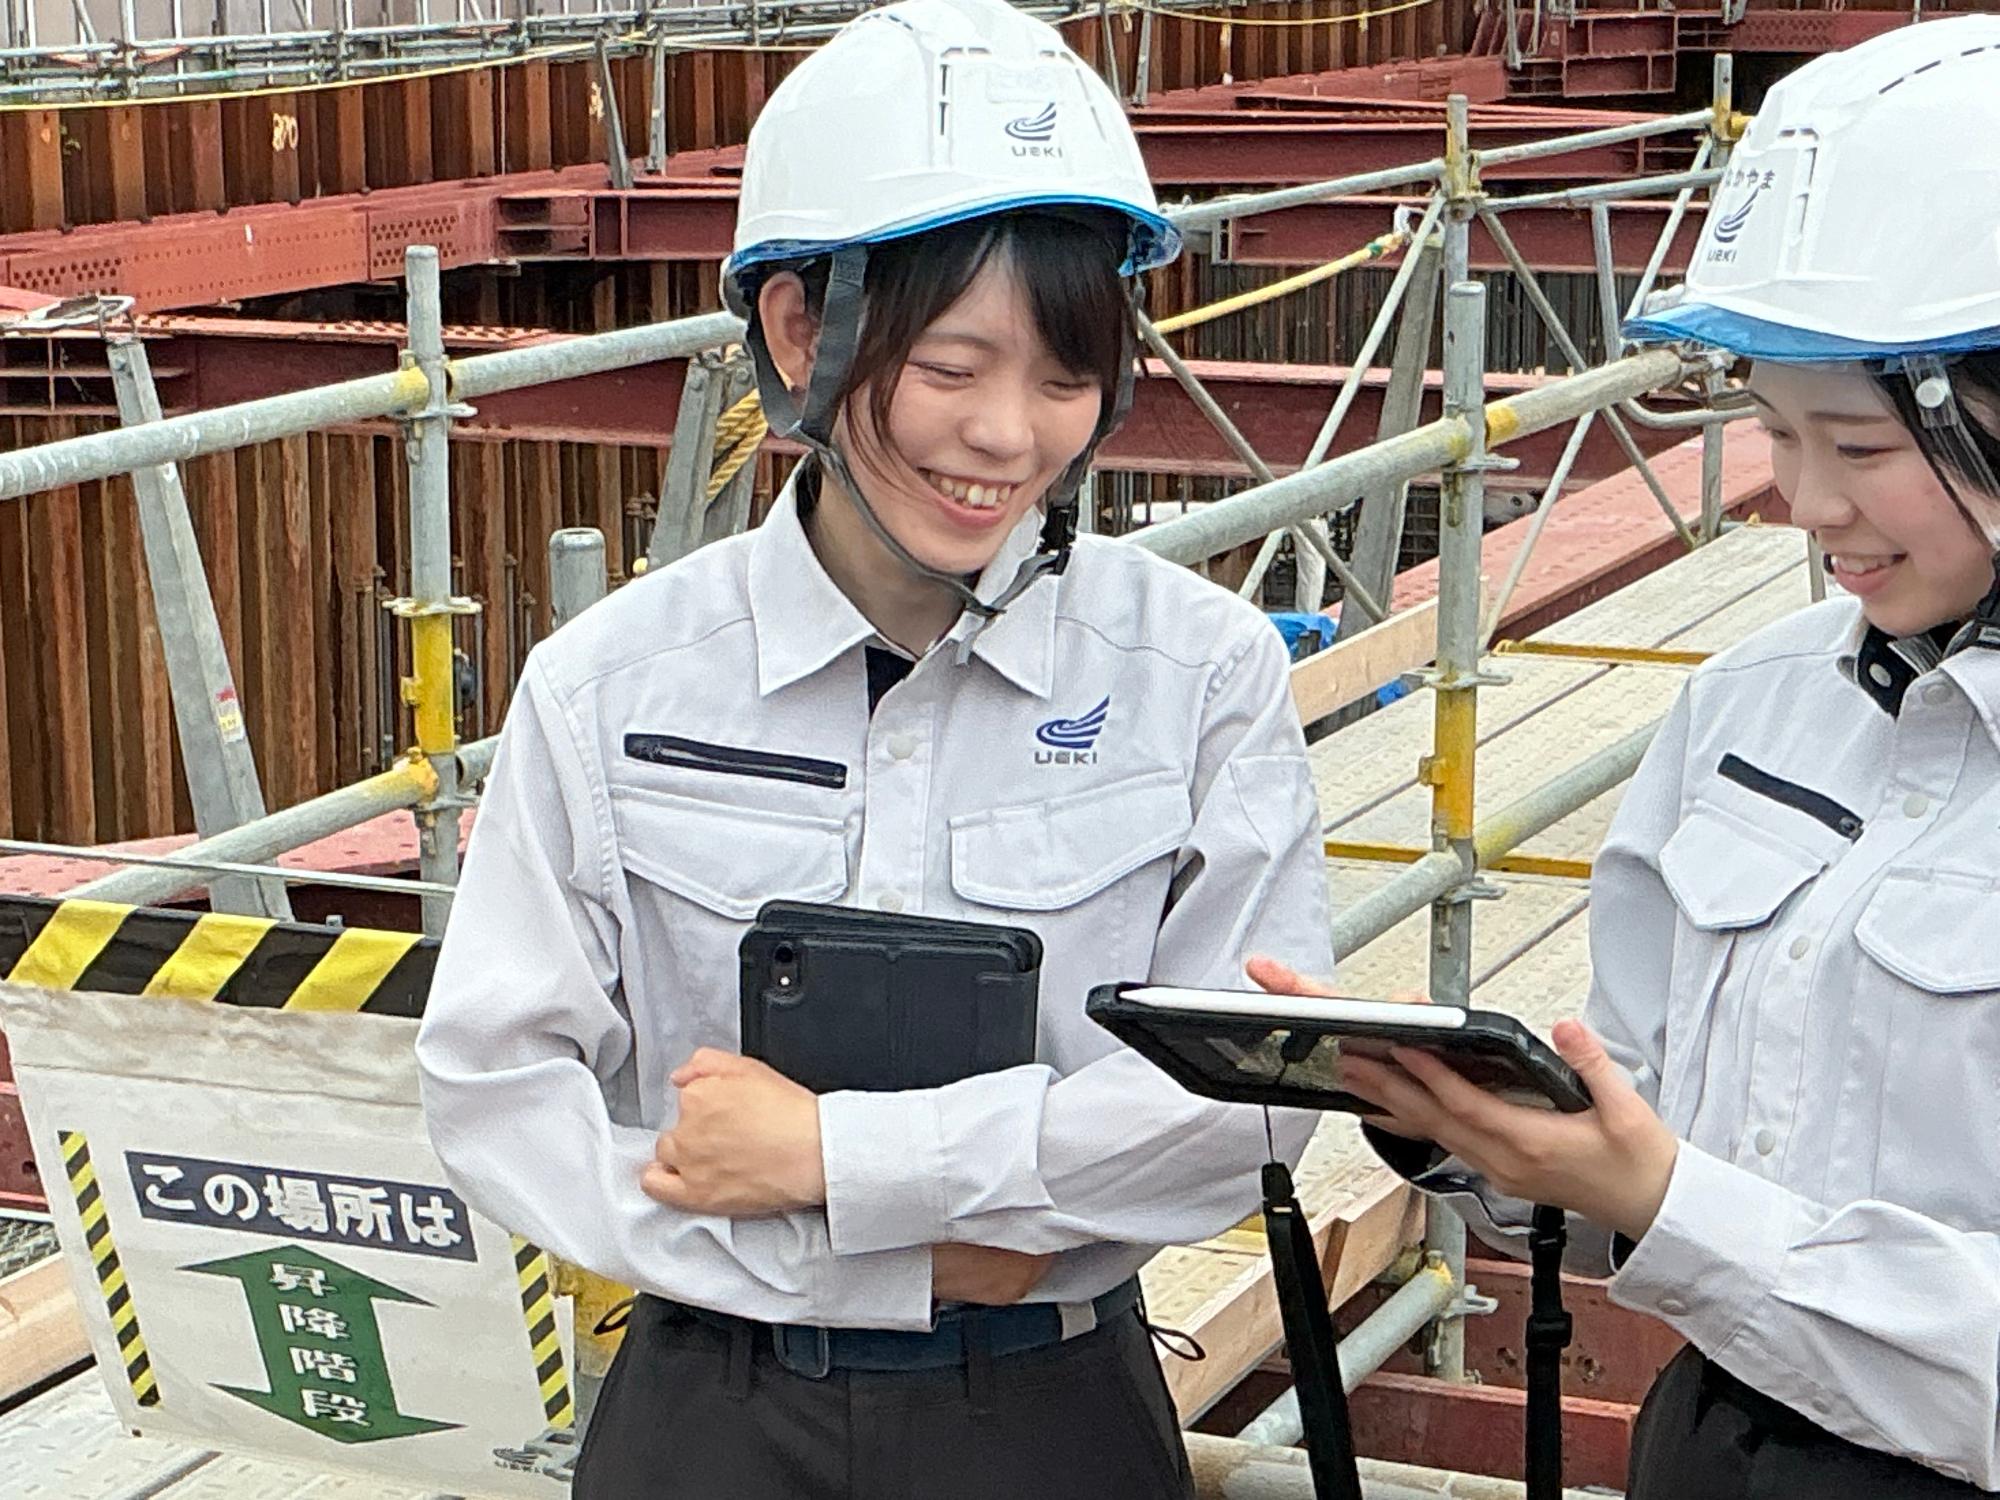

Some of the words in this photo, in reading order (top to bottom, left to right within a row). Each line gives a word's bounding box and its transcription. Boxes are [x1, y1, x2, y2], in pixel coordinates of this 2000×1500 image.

[1011, 145, 1063, 158] UEKI
[1706, 248, 1738, 263] UEKI
[1034, 750, 1098, 765] UEKI
[142, 1163, 462, 1248] この場所は
[269, 1262, 373, 1428] 昇降階段
